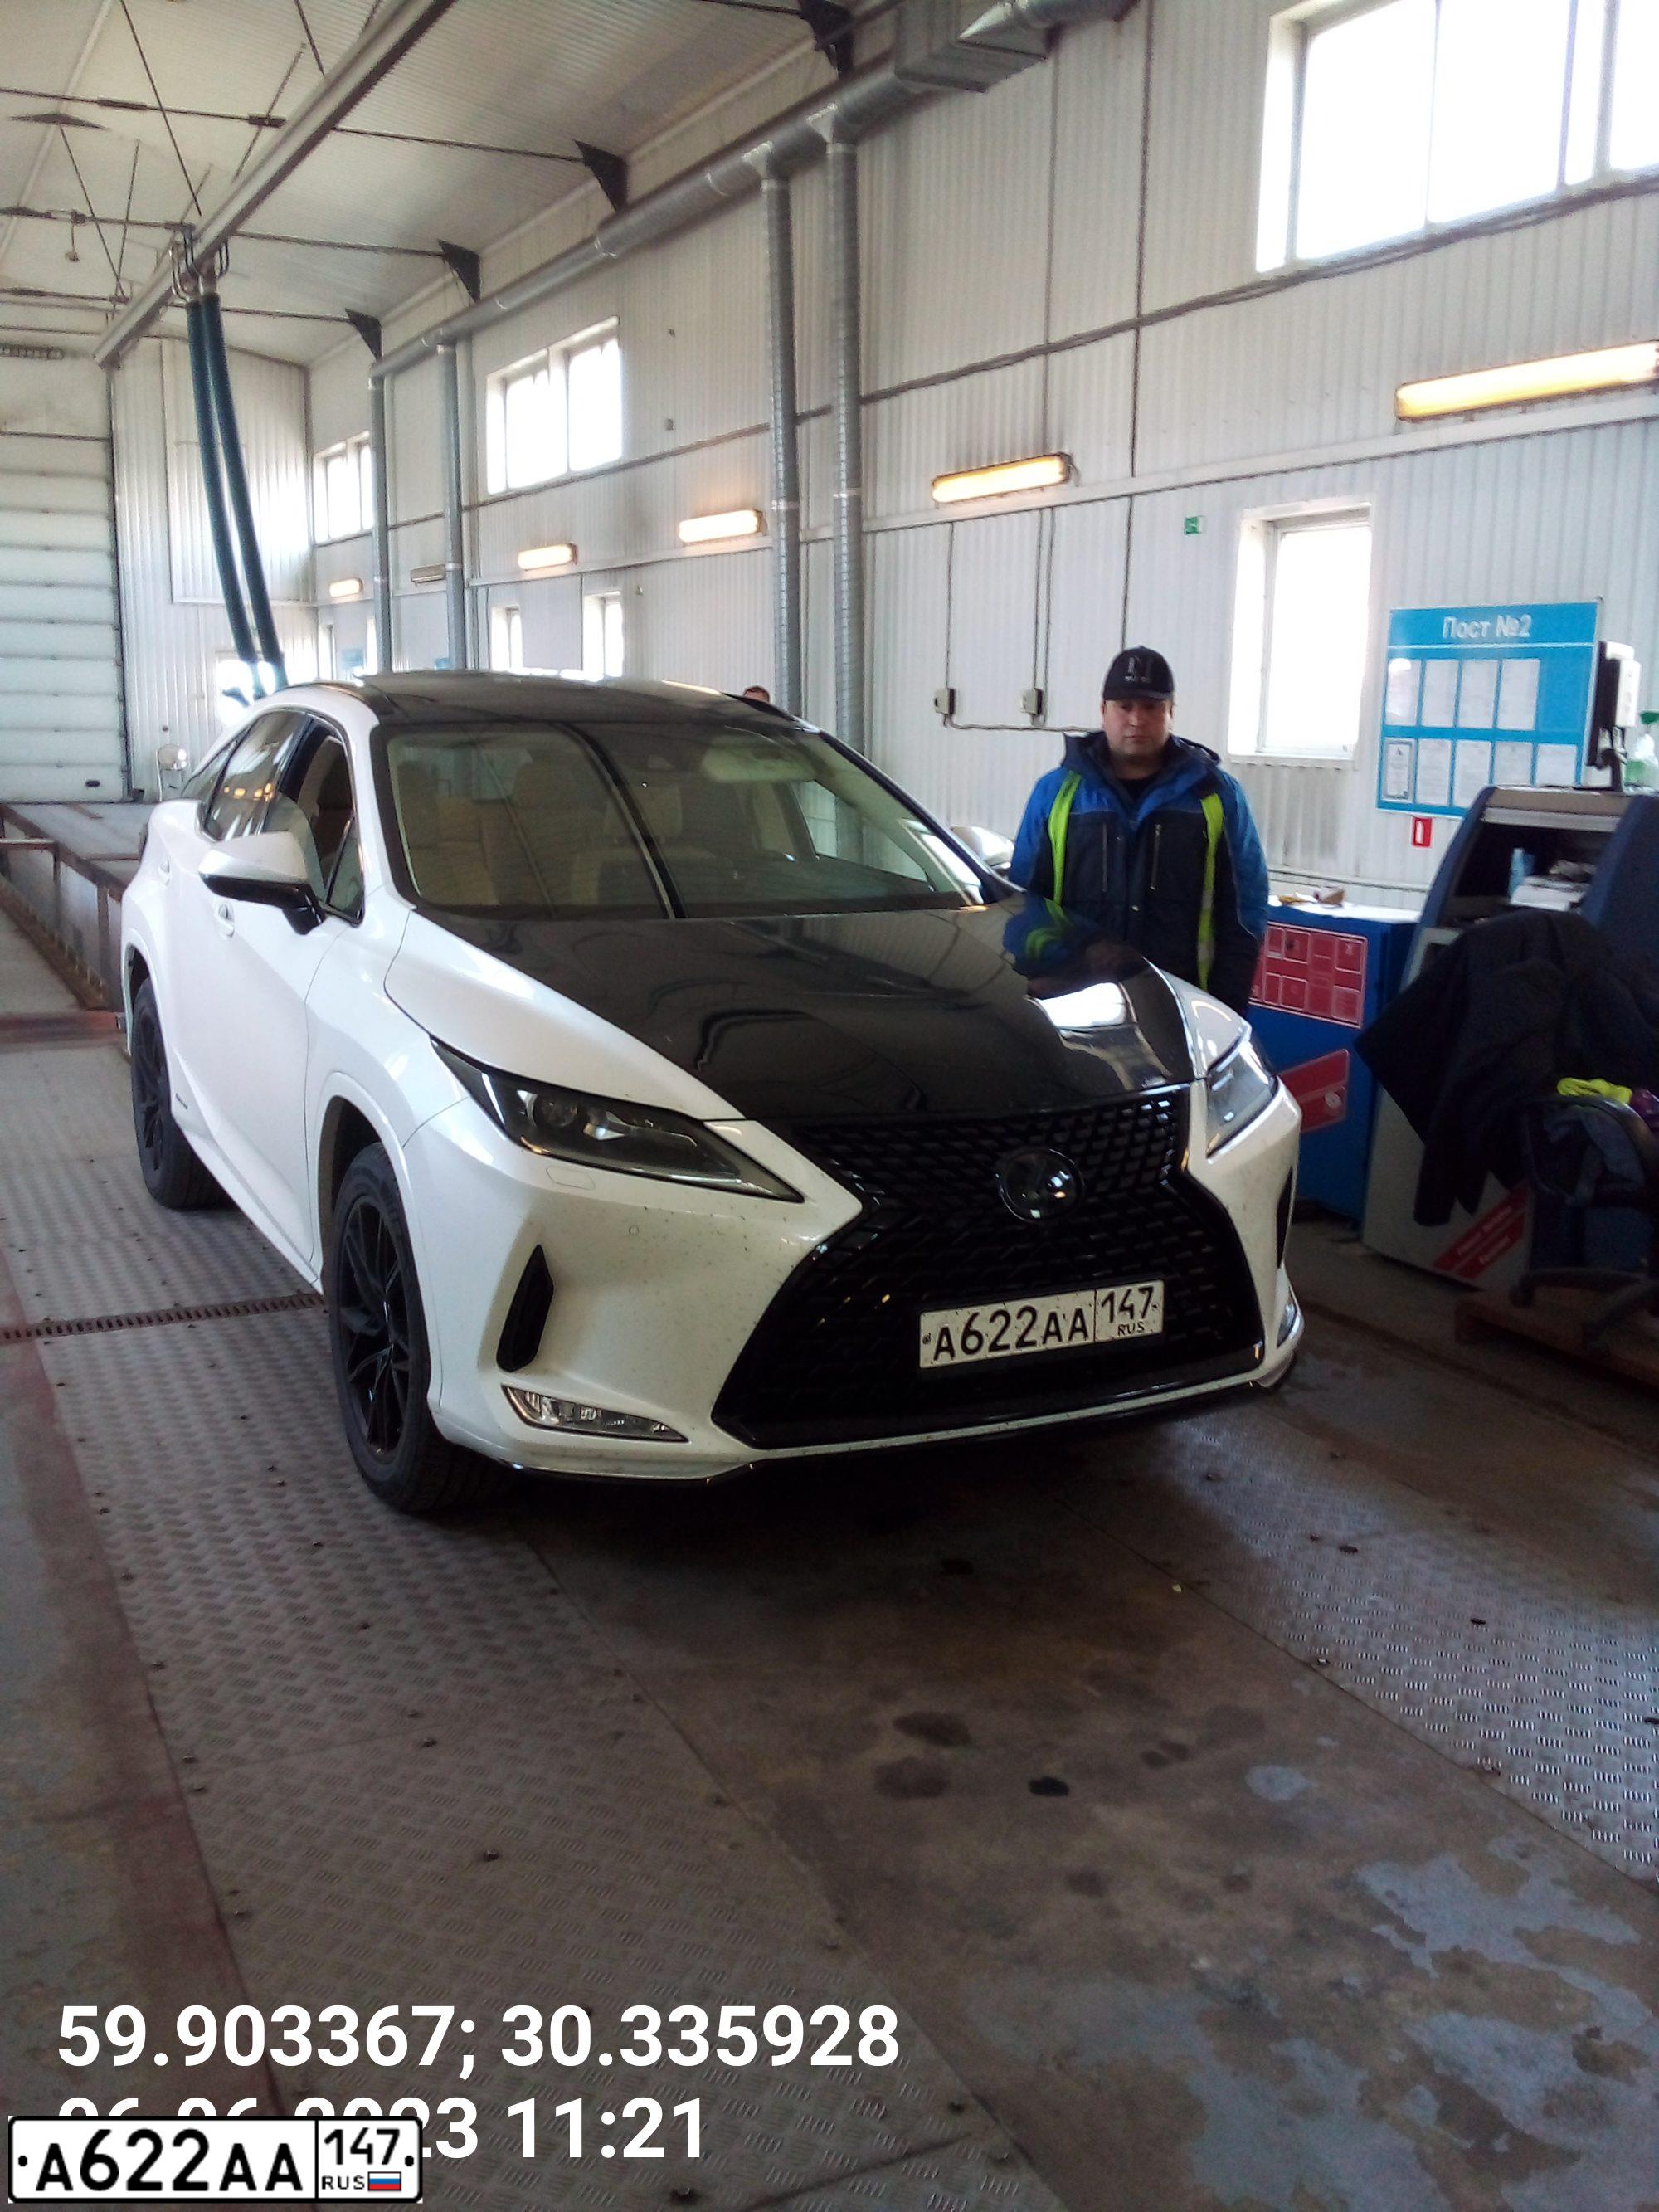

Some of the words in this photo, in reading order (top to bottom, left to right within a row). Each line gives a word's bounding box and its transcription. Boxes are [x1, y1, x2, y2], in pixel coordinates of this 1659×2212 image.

[1442, 616, 1491, 638] Пост
[1496, 615, 1533, 638] №2
[1100, 1287, 1155, 1323] 147
[1117, 1322, 1146, 1336] RUS
